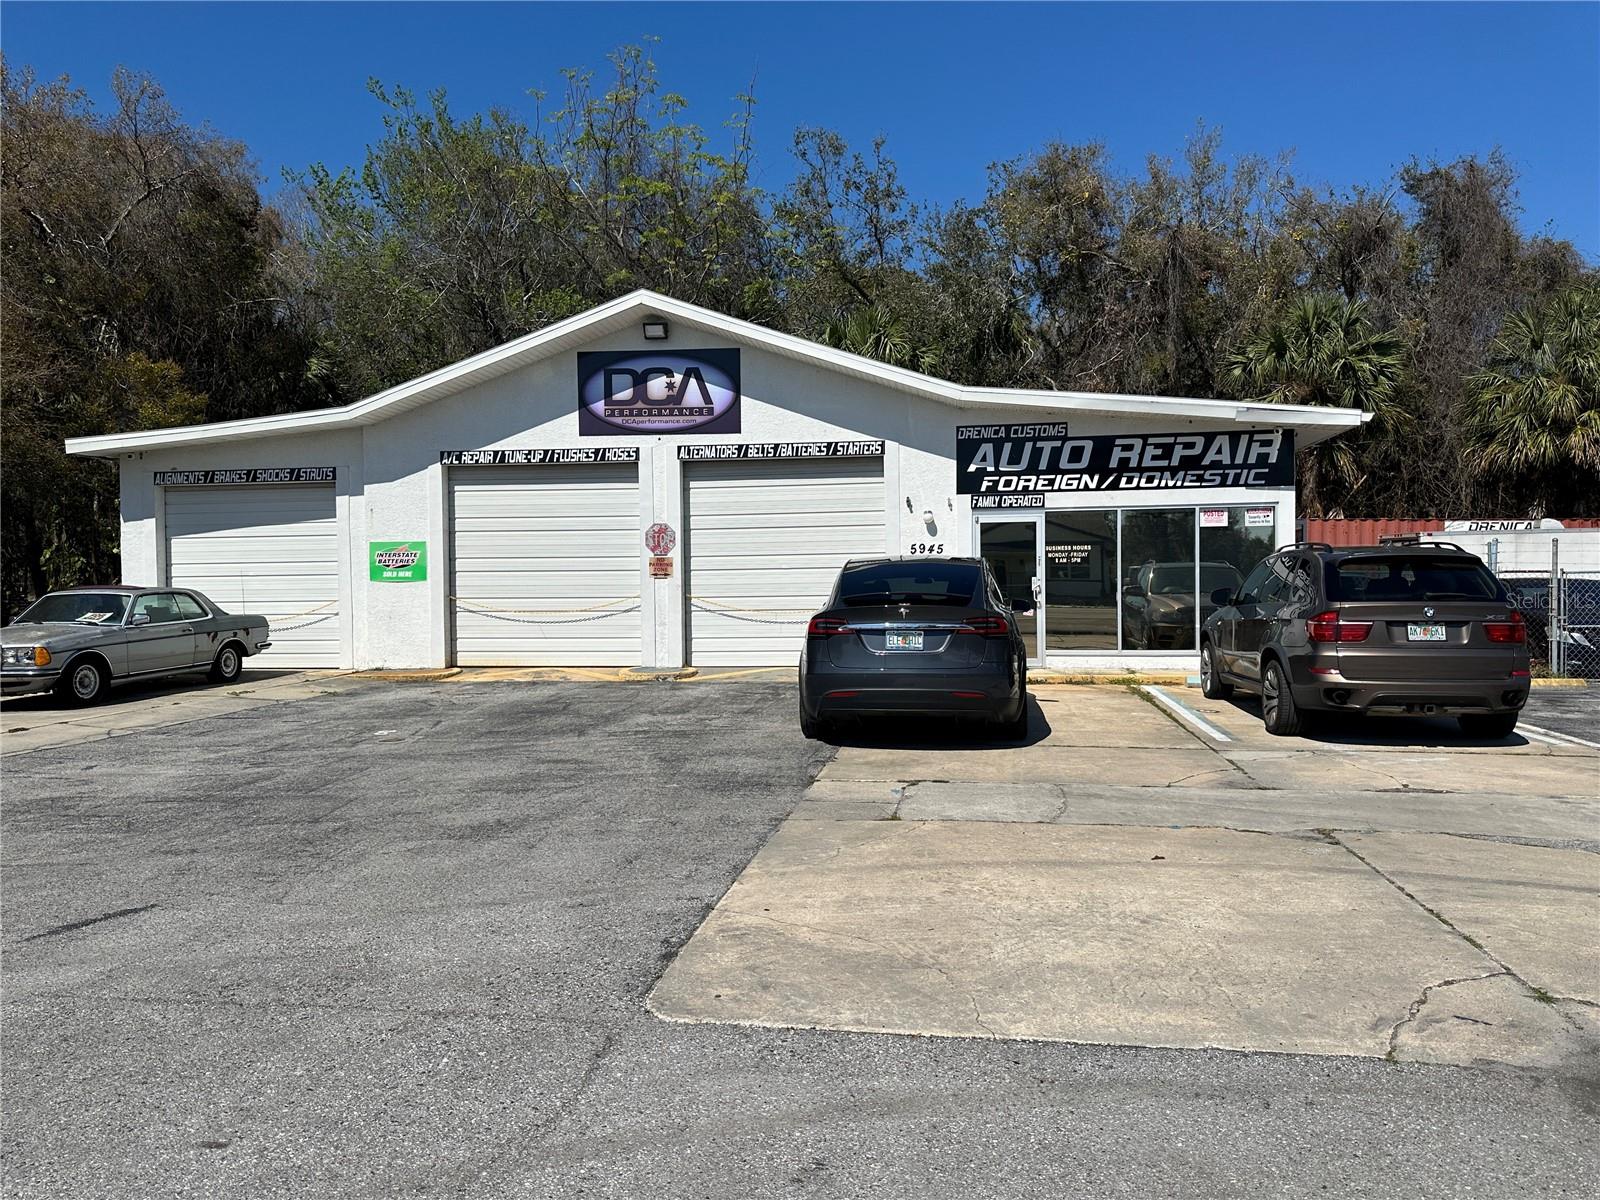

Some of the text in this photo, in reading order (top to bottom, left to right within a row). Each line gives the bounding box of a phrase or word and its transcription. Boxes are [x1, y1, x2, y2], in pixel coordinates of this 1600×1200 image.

[603, 367, 714, 406] DCA
[605, 408, 709, 416] PERFORMANCE
[621, 418, 697, 426] DCAperformance.com
[958, 424, 1066, 440] DRENICA CUSTOMS
[442, 451, 460, 464] A/C
[461, 450, 494, 463] REPAIR
[504, 450, 545, 463] TUNE-UP
[553, 449, 596, 462] FLUSHES
[605, 447, 636, 460] HOSES
[678, 445, 739, 459] ALTERNATORS
[748, 444, 775, 457] BELTS
[836, 441, 882, 455] STARTERS
[967, 432, 1283, 473] AUTO REPAIR
[155, 472, 205, 485] ALIGNMENTS
[214, 470, 247, 482] BRAKES
[256, 469, 290, 482] SHOCKS
[300, 468, 333, 480] STRUTS
[980, 473, 1099, 492] FOREIGN
[1119, 468, 1269, 488] DOMESTIC
[972, 494, 1044, 508] FAMILY OPERATED
[910, 543, 944, 555] 5945
